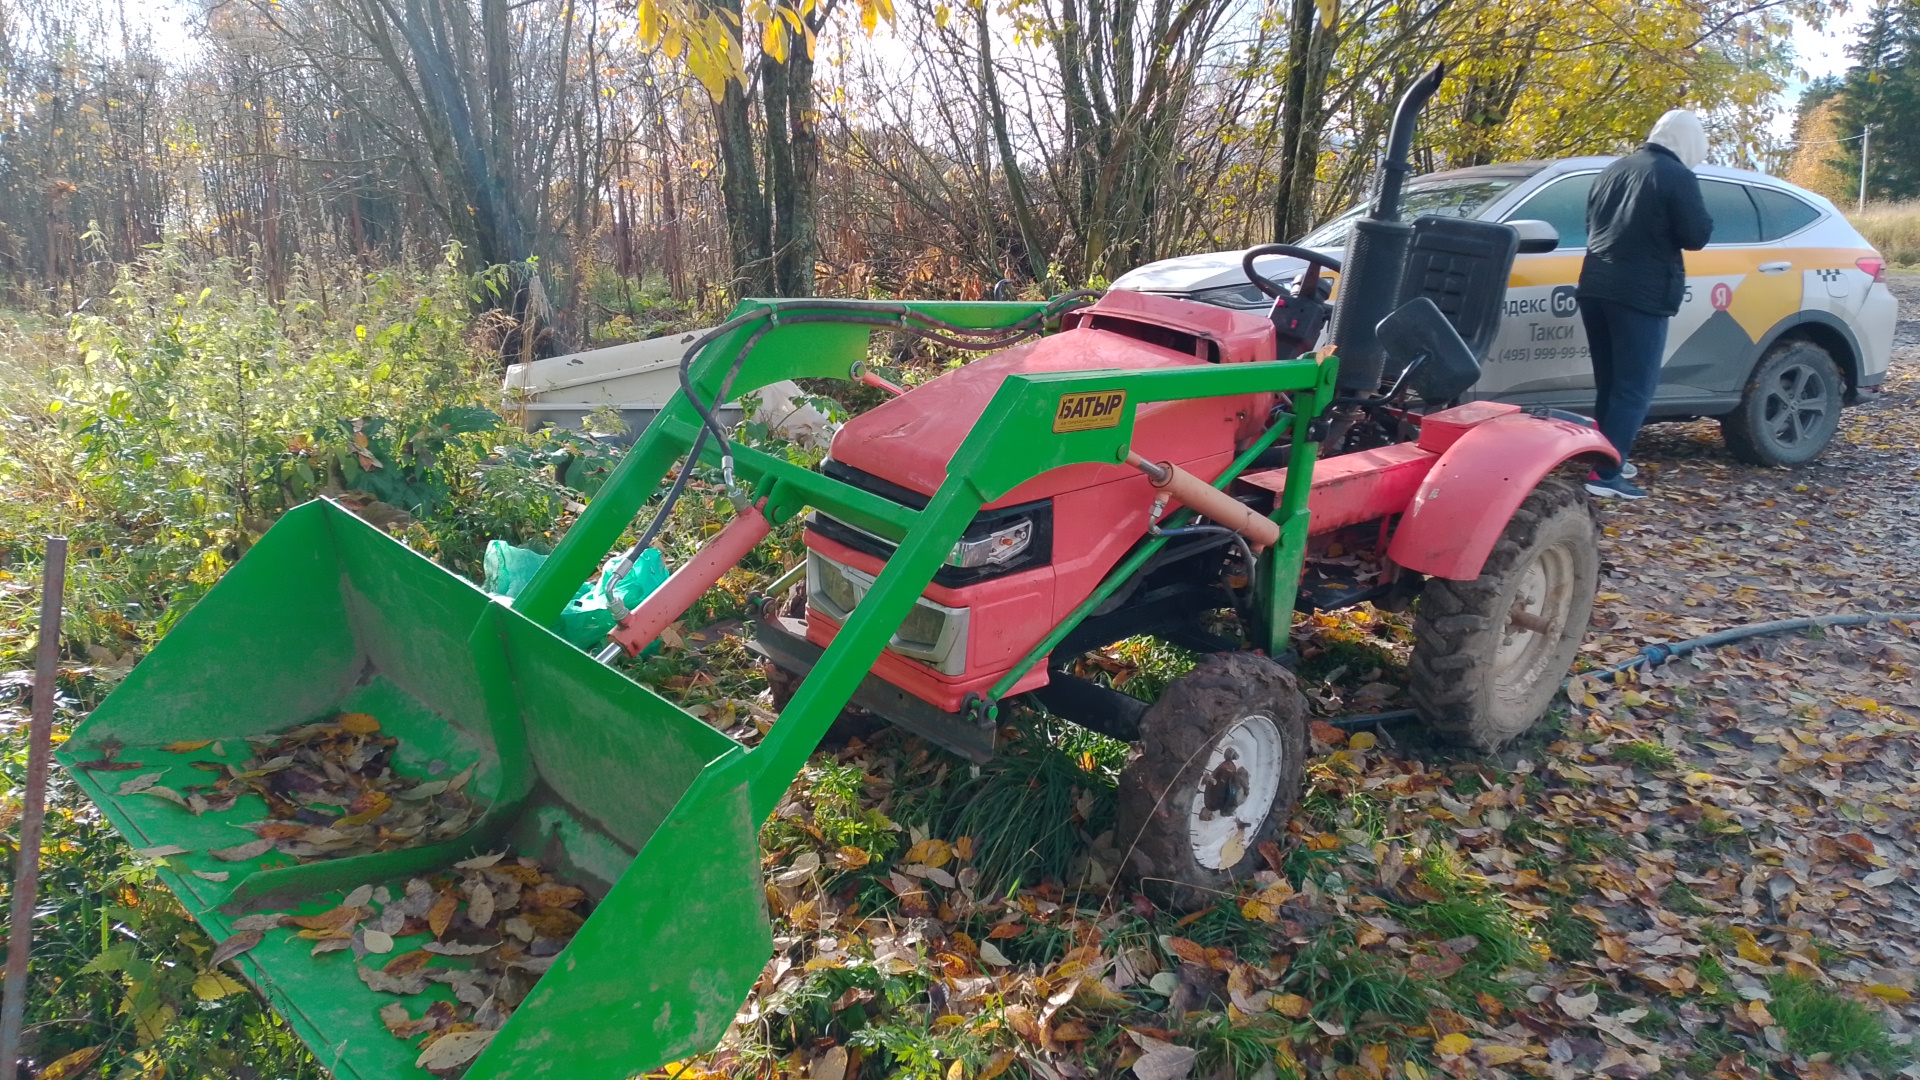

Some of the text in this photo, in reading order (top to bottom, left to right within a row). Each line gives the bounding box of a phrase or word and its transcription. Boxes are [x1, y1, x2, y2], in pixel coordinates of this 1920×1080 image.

[1502, 292, 1577, 317] ндекс Go
[1714, 287, 1727, 306] Я
[1529, 322, 1575, 342] Такси
[1498, 348, 1530, 364] (495)
[1058, 394, 1122, 419] БАТЫР
